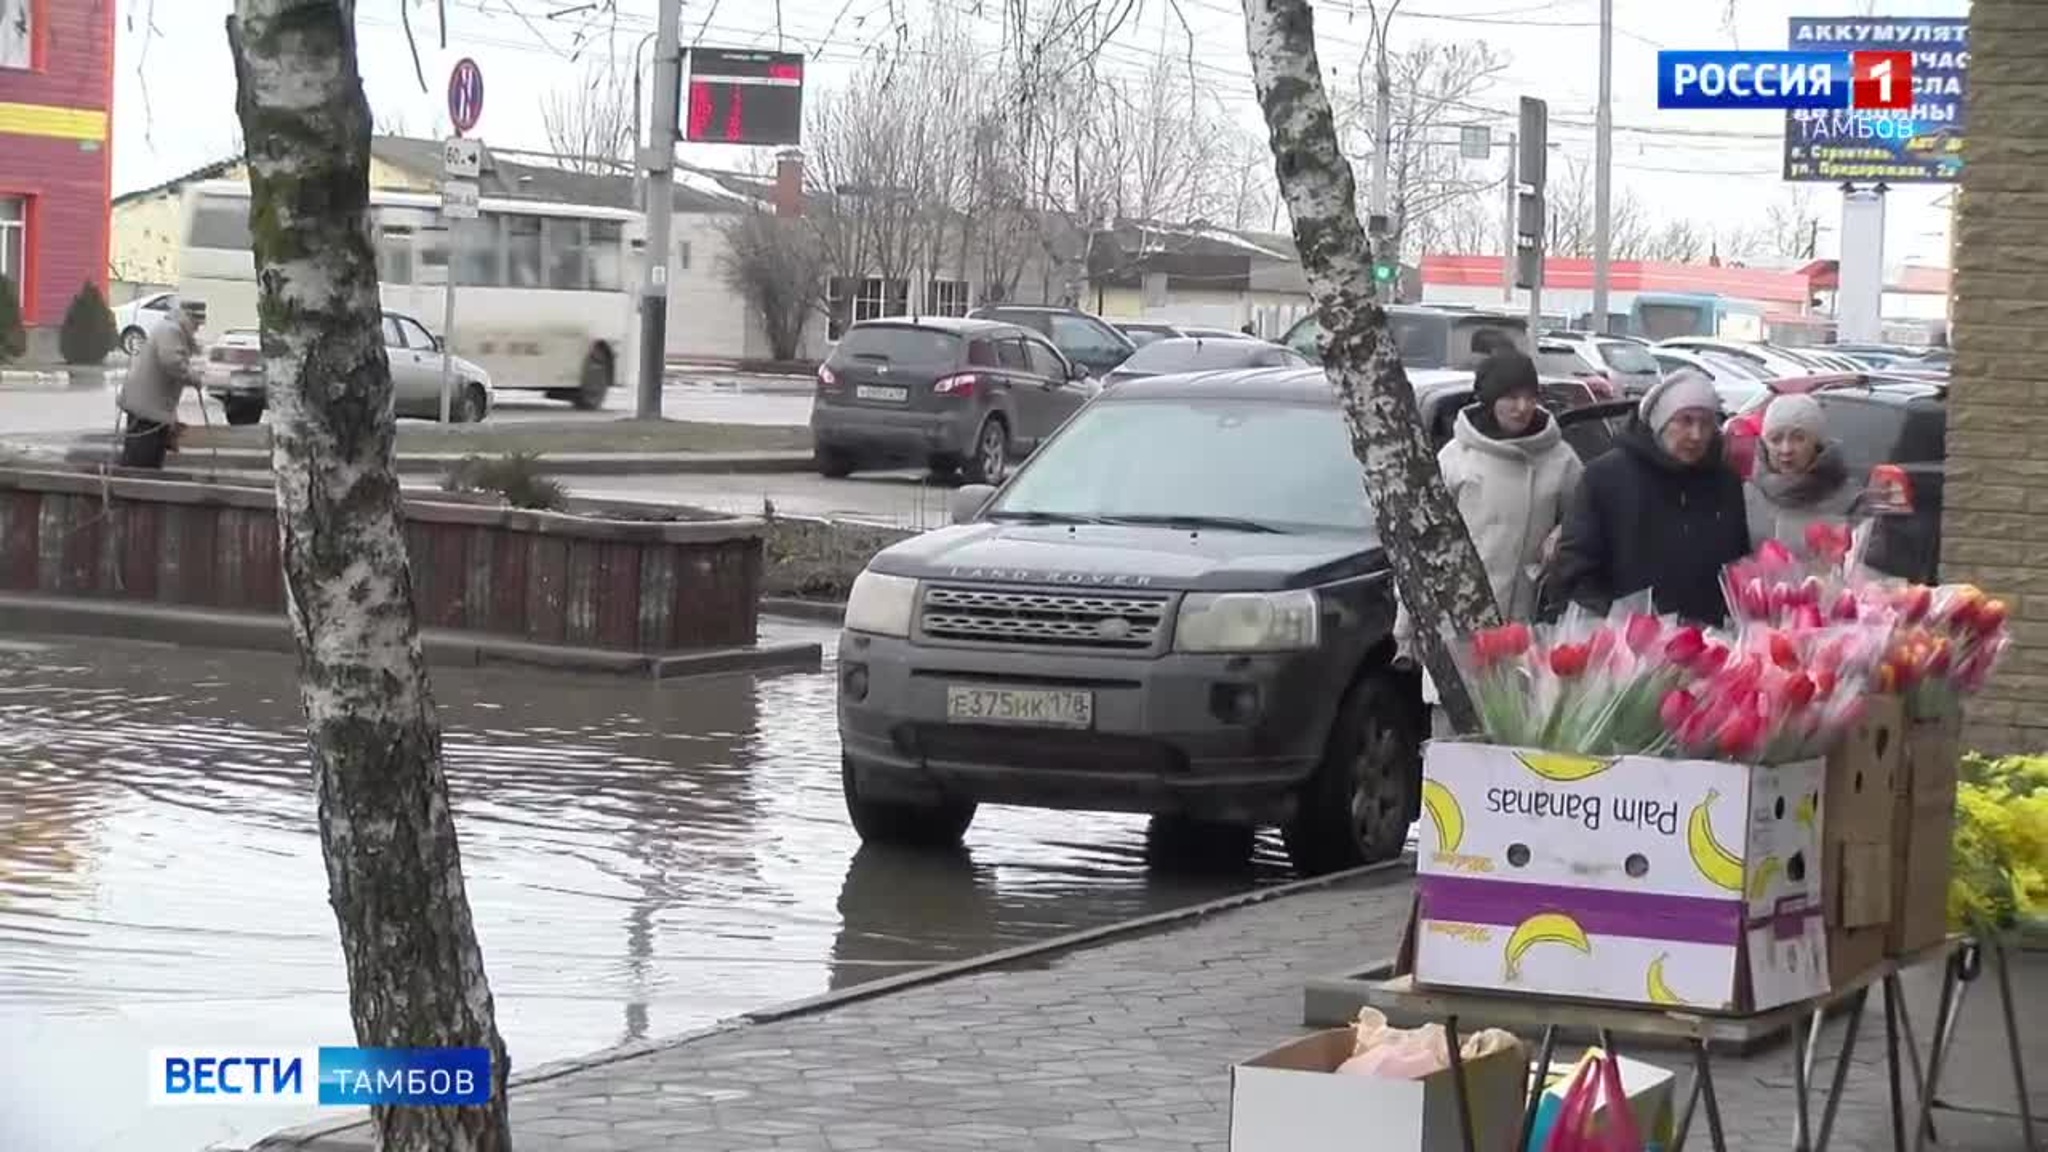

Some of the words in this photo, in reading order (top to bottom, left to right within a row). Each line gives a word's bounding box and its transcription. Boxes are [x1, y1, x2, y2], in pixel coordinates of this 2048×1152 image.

[1797, 25, 1971, 41] АККУМУЛЯТ
[1487, 787, 1600, 830] Bananas
[1613, 797, 1678, 835] Palm
